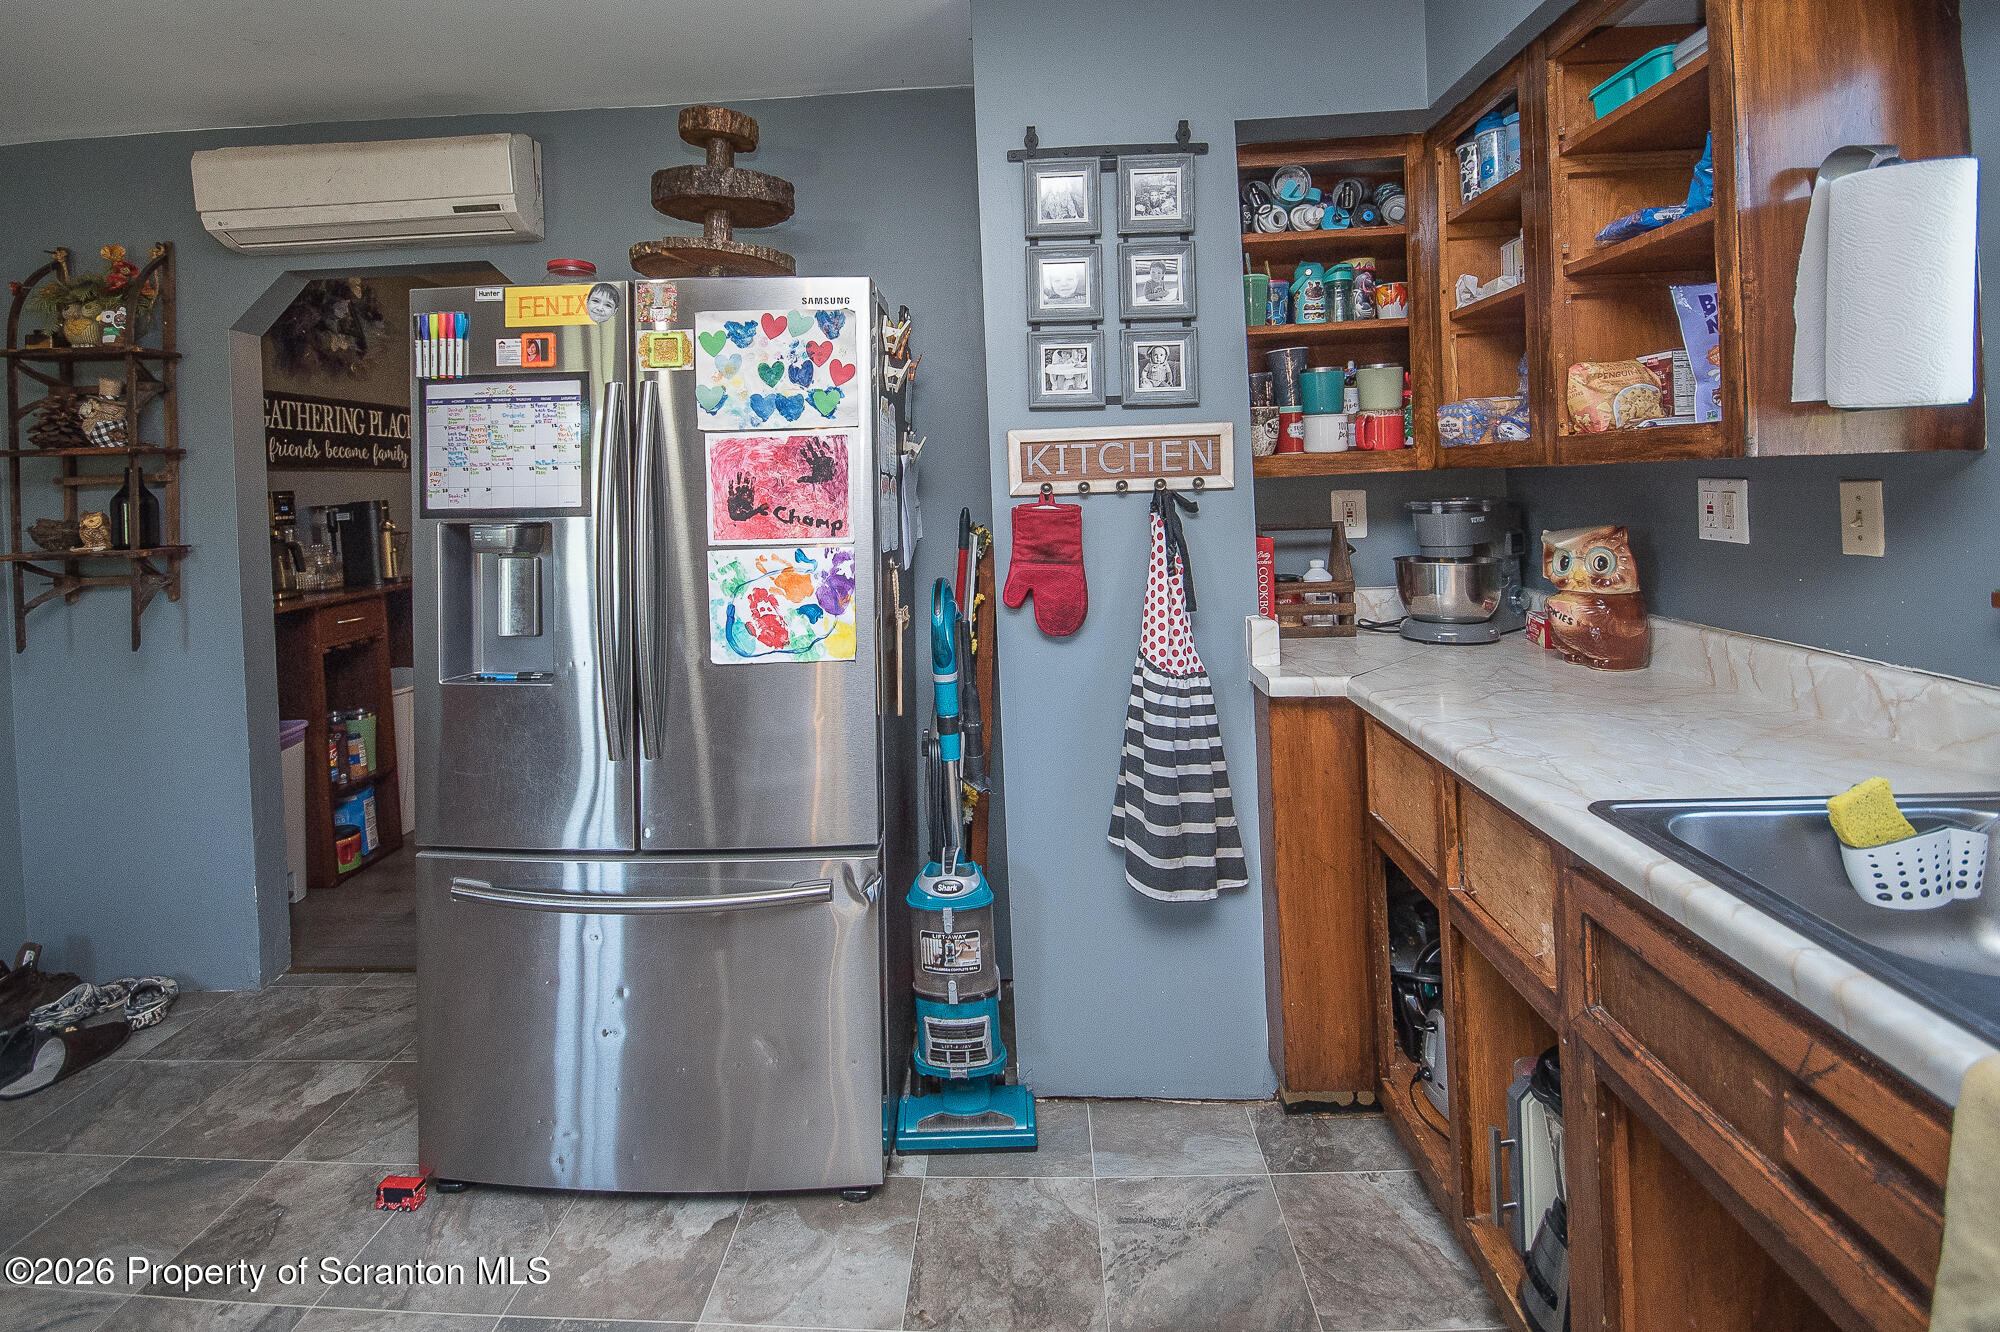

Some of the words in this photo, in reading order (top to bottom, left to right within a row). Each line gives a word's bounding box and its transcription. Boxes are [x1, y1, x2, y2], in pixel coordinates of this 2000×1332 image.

[478, 290, 501, 298] Hunter
[518, 293, 589, 319] FENIX
[801, 296, 851, 305] SAMSUNG
[492, 387, 510, 396] June
[268, 436, 321, 463] friends
[325, 439, 370, 459] become
[373, 443, 409, 469] family
[1027, 439, 1214, 476] KITCHEN
[772, 505, 843, 537] Champ
[1258, 566, 1269, 618] COOKBO
[937, 883, 958, 892] Shark
